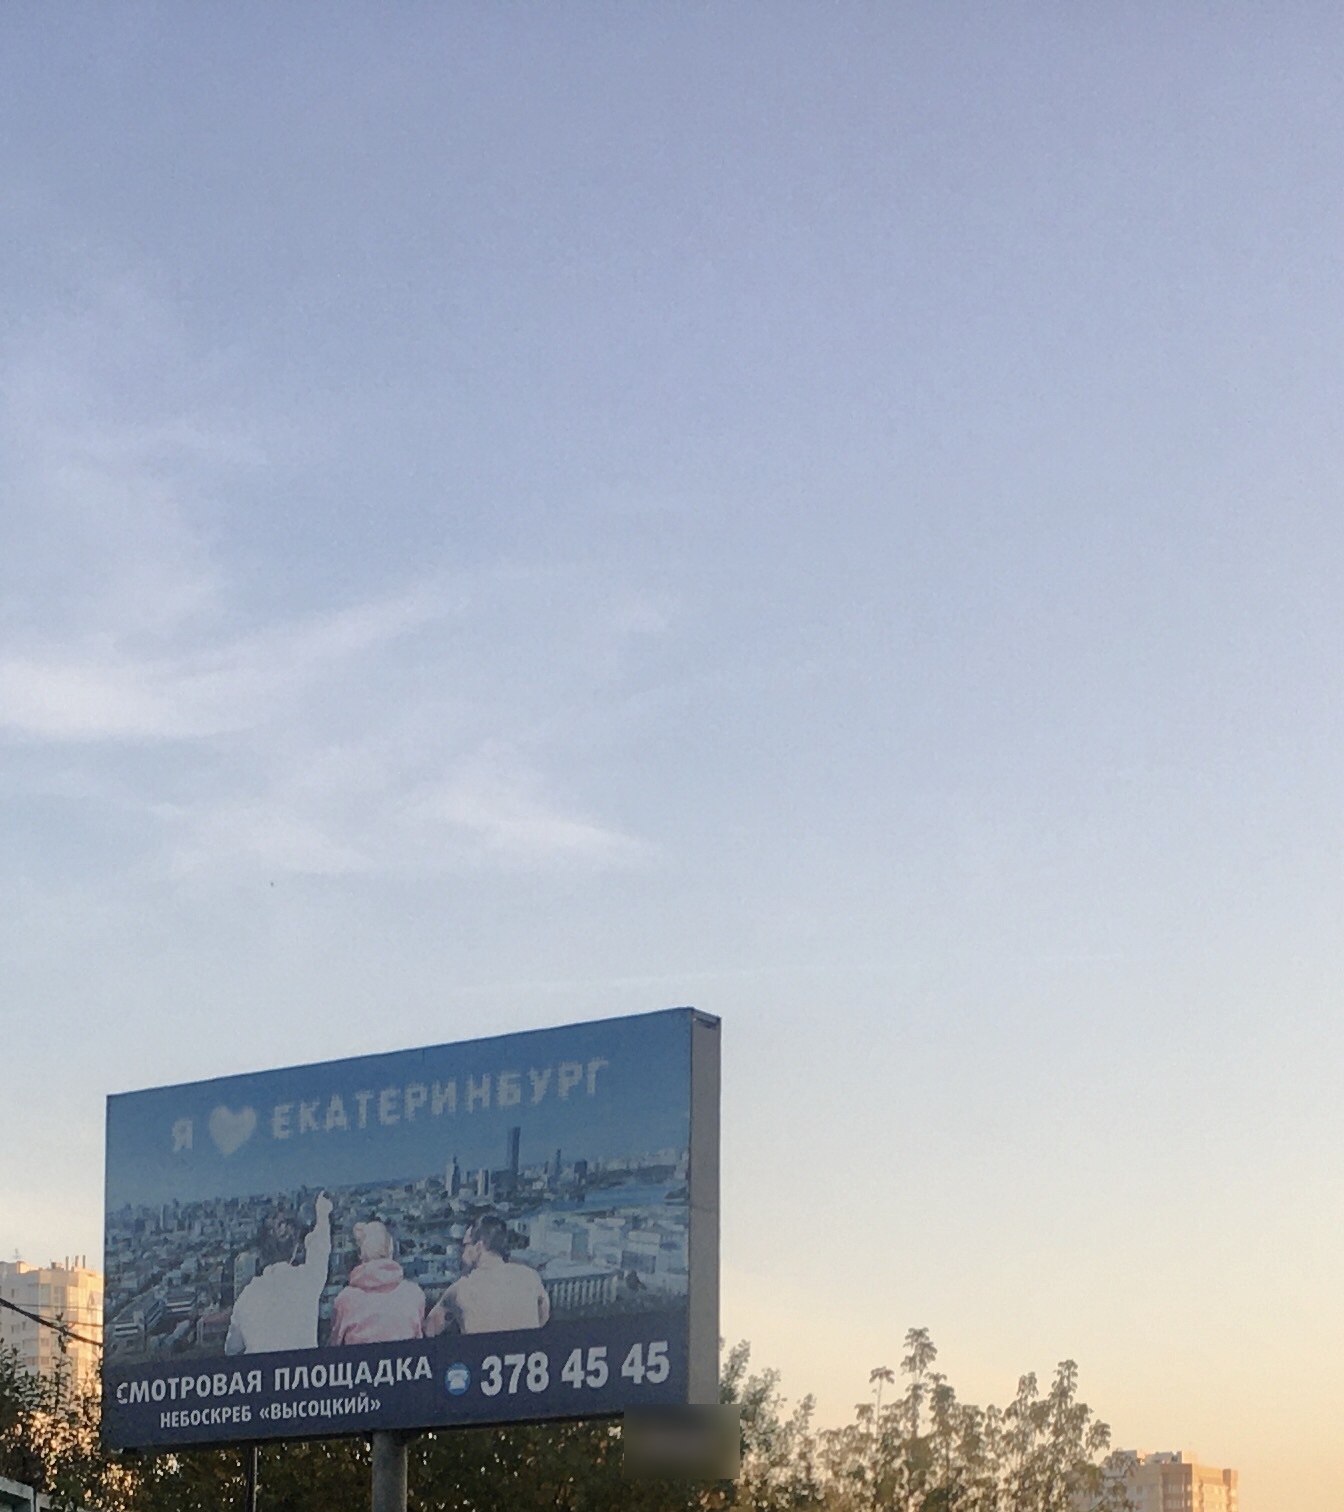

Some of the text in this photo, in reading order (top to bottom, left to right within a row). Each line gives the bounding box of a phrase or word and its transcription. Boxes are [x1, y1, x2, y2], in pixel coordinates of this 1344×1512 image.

[172, 1057, 609, 1153] Я ЕКАТЕРИНБУРГ
[117, 1356, 433, 1405] СМОТРОВАЯ ПЛОЩАДКА
[480, 1340, 670, 1397] 378 45 45
[160, 1392, 382, 1428] НЕБОСКРЕБ «ВЫСОЦКИЙ»
